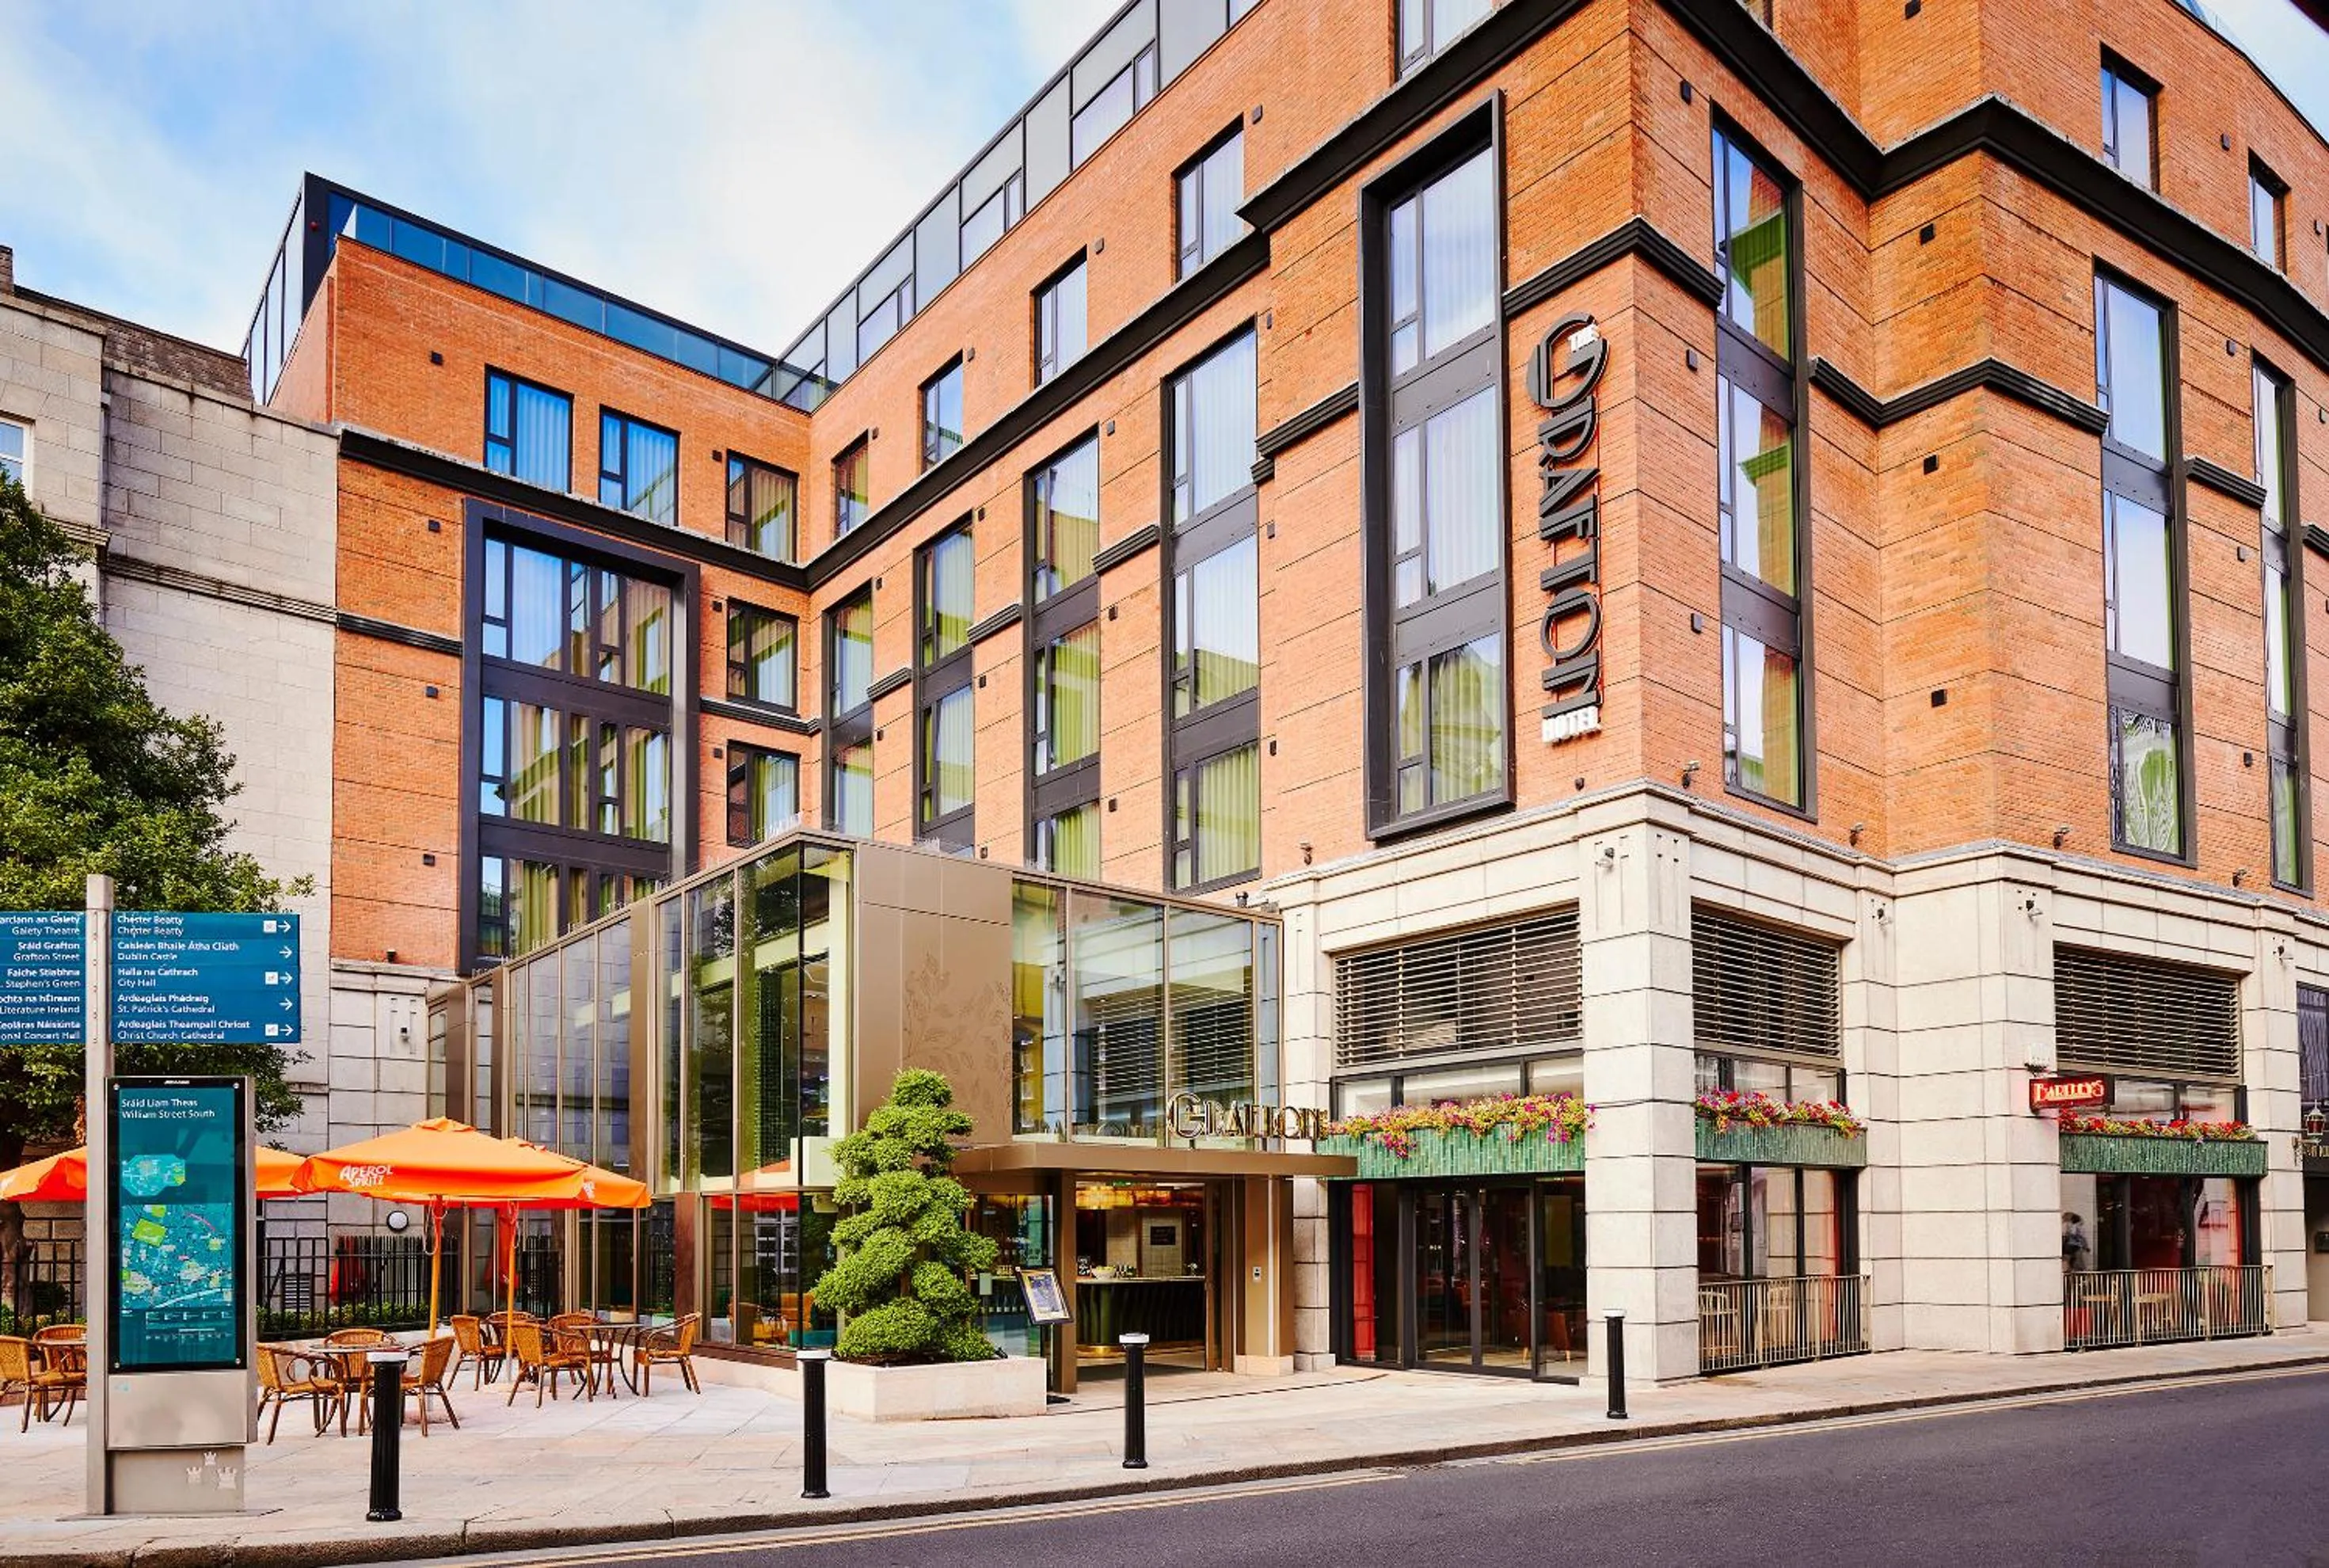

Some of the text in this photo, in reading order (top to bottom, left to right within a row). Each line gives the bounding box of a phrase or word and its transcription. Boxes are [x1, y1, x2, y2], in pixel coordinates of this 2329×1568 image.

[1526, 310, 1610, 718] GRAFTON
[1540, 704, 1602, 744] HOTEL
[0, 915, 33, 924] arclann
[51, 915, 80, 926] Gaiety
[117, 915, 184, 925] Chester Beatty
[12, 927, 80, 937] Gaiety Theatre
[117, 926, 184, 937] Chester Beatty
[44, 941, 80, 950] Grafton
[158, 941, 186, 950] Bhaile
[212, 941, 239, 950] Cliath
[13, 953, 50, 961] Grafton
[7, 968, 37, 977] Faiche
[118, 967, 142, 976] Halla
[158, 967, 198, 976] Cathrach
[6, 980, 50, 989] Stephen's
[52, 980, 81, 988] Green
[117, 978, 156, 988] City Hall
[0, 995, 22, 1003] ochta
[118, 993, 166, 1003] Ardeaglais
[117, 1004, 215, 1014] St. Patrick's Cathedral
[0, 1021, 34, 1029] eoláras
[118, 1020, 166, 1029] Ardeaglais
[169, 1019, 215, 1029] Theampall
[117, 1031, 225, 1040] Christ Church Cathedral
[147, 1099, 169, 1108] Liam
[170, 1098, 198, 1107] Theas
[122, 1109, 215, 1119] William Street South
[339, 1165, 394, 1181] APEROL
[348, 1174, 385, 1187] SPRITZ
